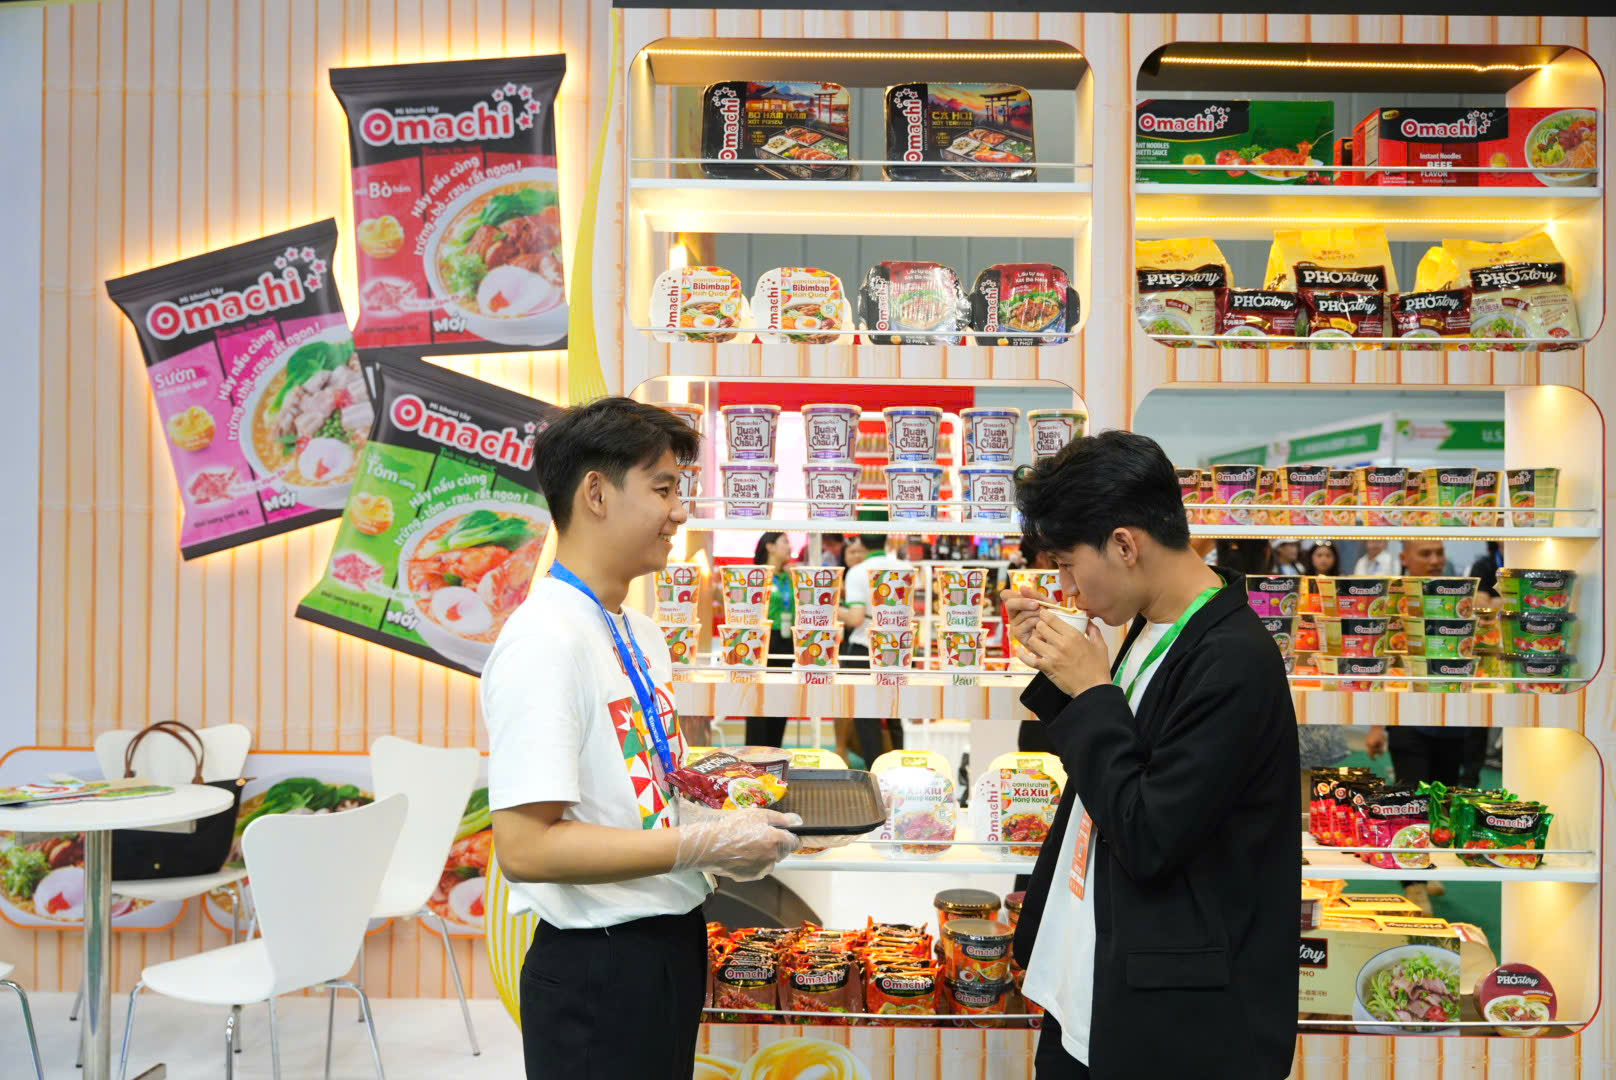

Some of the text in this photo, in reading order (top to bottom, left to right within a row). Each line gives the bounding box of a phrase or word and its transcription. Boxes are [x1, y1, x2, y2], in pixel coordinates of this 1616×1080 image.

[360, 101, 514, 146] Omachi
[718, 96, 741, 161] Omachi
[902, 98, 924, 162] Omachi
[1138, 112, 1214, 132] Omachi
[1400, 118, 1478, 138] Omachi
[369, 180, 393, 199] Bò
[411, 156, 480, 218] Hãy nấu cùng
[413, 222, 434, 256] trứng
[430, 201, 446, 217] bò
[692, 283, 730, 291] Bibimbap
[792, 284, 829, 293] Bibimbap
[146, 266, 306, 340] Omachi
[666, 285, 679, 334] Omachi
[984, 287, 998, 332] Omachi
[768, 288, 778, 336] Omachi
[218, 329, 277, 401] Hãy nấu cùng
[390, 394, 535, 472] Omachi
[1216, 471, 1250, 481] Omachi
[1290, 472, 1324, 482] Omachi
[1368, 472, 1403, 483] Omachi
[409, 490, 432, 509] Hãy
[433, 476, 456, 495] nấu
[457, 473, 488, 488] cùng
[1437, 586, 1468, 594] Omachi
[1354, 626, 1382, 634] Omachi
[1439, 626, 1470, 634] Omachi
[1440, 665, 1470, 673] Omachi
[988, 791, 998, 842] Omachi
[1370, 802, 1419, 815] Omachi
[1486, 815, 1527, 828] Omachi
[966, 946, 1001, 956] Omachi
[725, 968, 768, 979] Omachi
[796, 972, 837, 985] Omachi
[882, 978, 925, 990] Omachi
[954, 990, 996, 1004] Omachi
